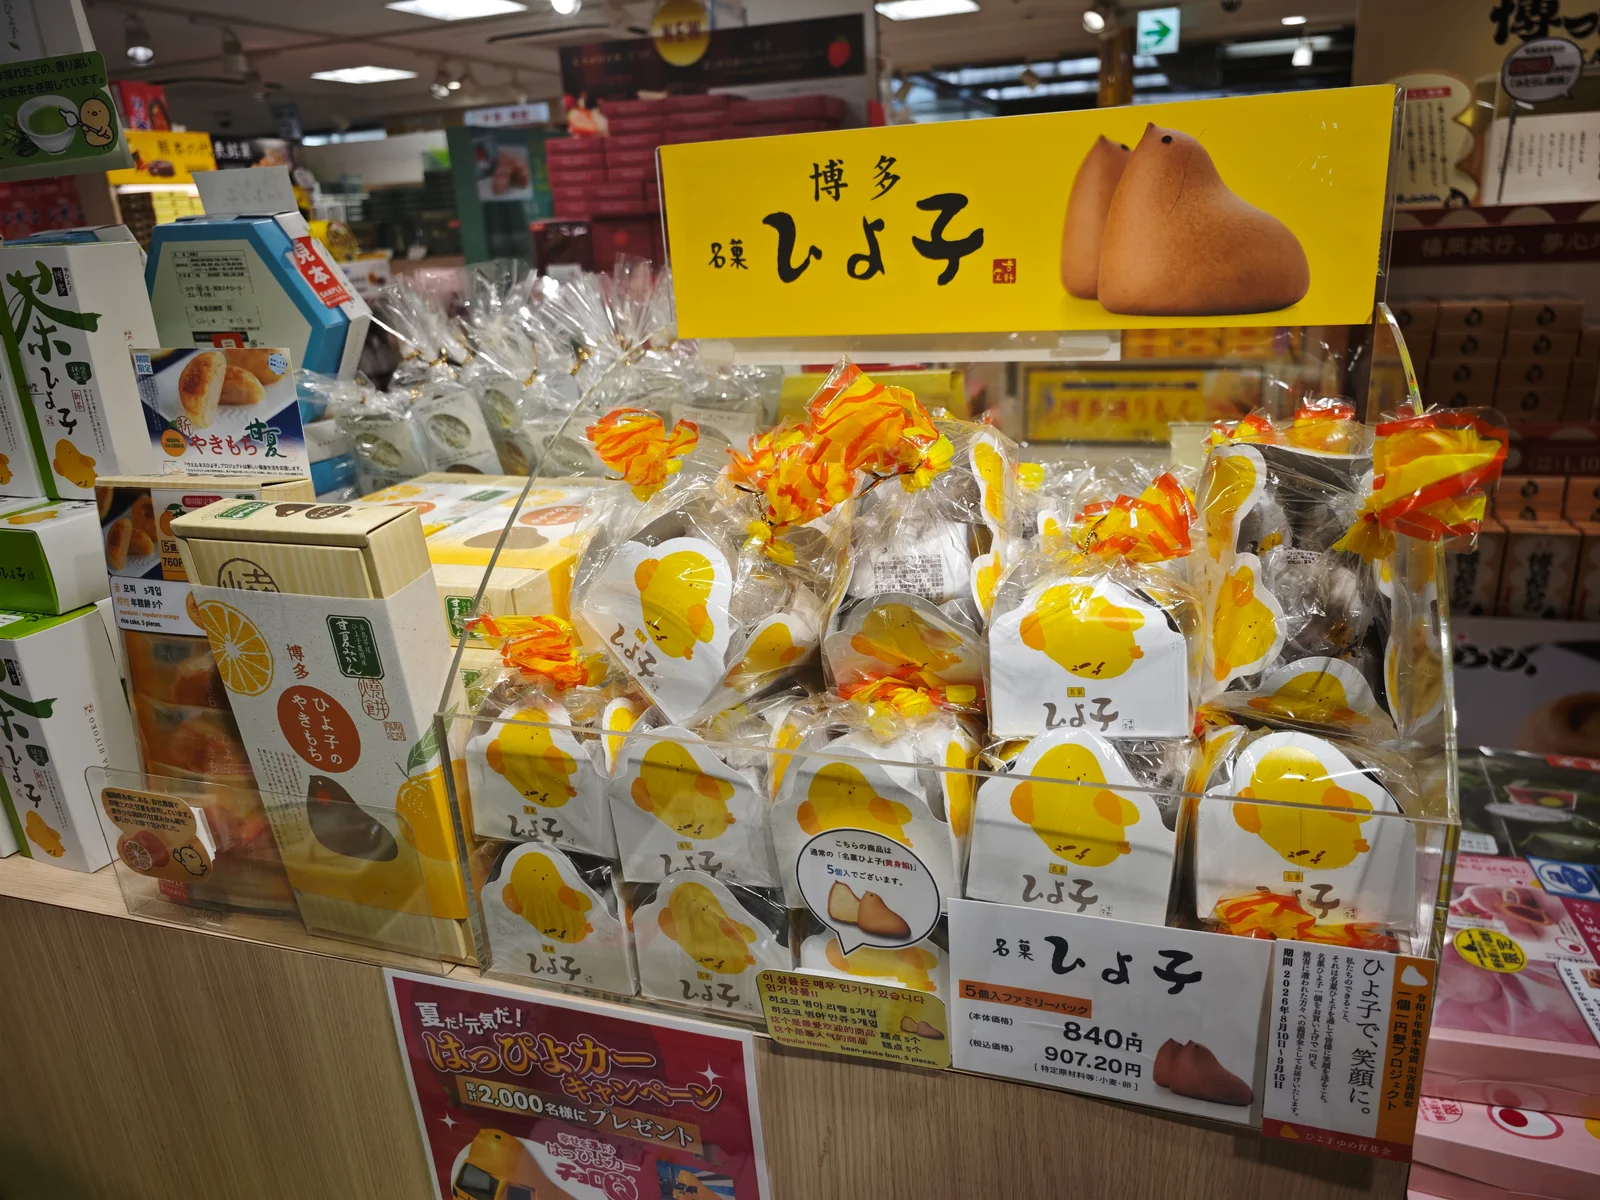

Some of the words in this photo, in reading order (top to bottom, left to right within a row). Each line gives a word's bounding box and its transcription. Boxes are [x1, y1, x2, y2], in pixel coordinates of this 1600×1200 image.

[810, 156, 901, 201] 博多
[708, 240, 749, 270] 名菓
[762, 193, 984, 286] ひよ子
[295, 241, 333, 286] 見本
[189, 434, 258, 456] やきもち
[245, 418, 287, 458] 甘夏
[286, 643, 309, 679] 博多
[335, 618, 363, 675] 甘夏みかん
[609, 622, 659, 679] ひよ子
[291, 694, 322, 762] やきもち
[312, 697, 343, 765] ひよ子の
[1043, 696, 1119, 732] ひよ子
[88, 716, 106, 755] HIYOKO
[507, 814, 564, 844] ひよ子
[835, 839, 892, 855] こちらの商品は
[659, 850, 723, 877] ひよ子
[826, 864, 904, 886] 5個入でございます。
[1021, 874, 1099, 913] ひよ子
[526, 952, 582, 982] ひよ子
[992, 938, 1035, 962] 名菓
[1044, 935, 1203, 995] ひよ子
[1282, 947, 1294, 968] 期間
[679, 979, 741, 1008] ひよ子
[763, 974, 773, 983] 이
[839, 983, 874, 997] 인기가
[877, 989, 925, 1005] 있습니다
[769, 995, 800, 1006] 히요코
[850, 1007, 877, 1018] 5개입
[965, 984, 1089, 1016] 5個入ファミリーパック
[1341, 957, 1355, 1023] 私たちのできること、
[414, 1001, 523, 1036] 夏だ!元気だ!
[771, 1005, 802, 1016] 히요코
[852, 1018, 878, 1028] 5개입
[968, 1011, 1014, 1026] (本体価格)
[1407, 993, 1427, 1064] 令和8年熊本地震
[422, 1030, 657, 1077] はっぴよカー
[777, 1035, 806, 1046] Popular
[806, 1039, 830, 1049] items.
[841, 1045, 883, 1057] bean-paste
[911, 1056, 938, 1066] pieces.
[904, 1036, 921, 1045] 5个
[906, 1045, 922, 1054] 5个
[1347, 958, 1385, 1115] ひよ子で、笑顔に。
[1386, 990, 1412, 1111] 一個一円愛プロジェクト
[969, 1038, 1014, 1053] (税込価格)
[1044, 1046, 1142, 1078] 907.20円
[560, 1074, 723, 1112] キャンペーン
[589, 1107, 694, 1148] プレゼント
[545, 1140, 642, 1172] はっぴよカー
